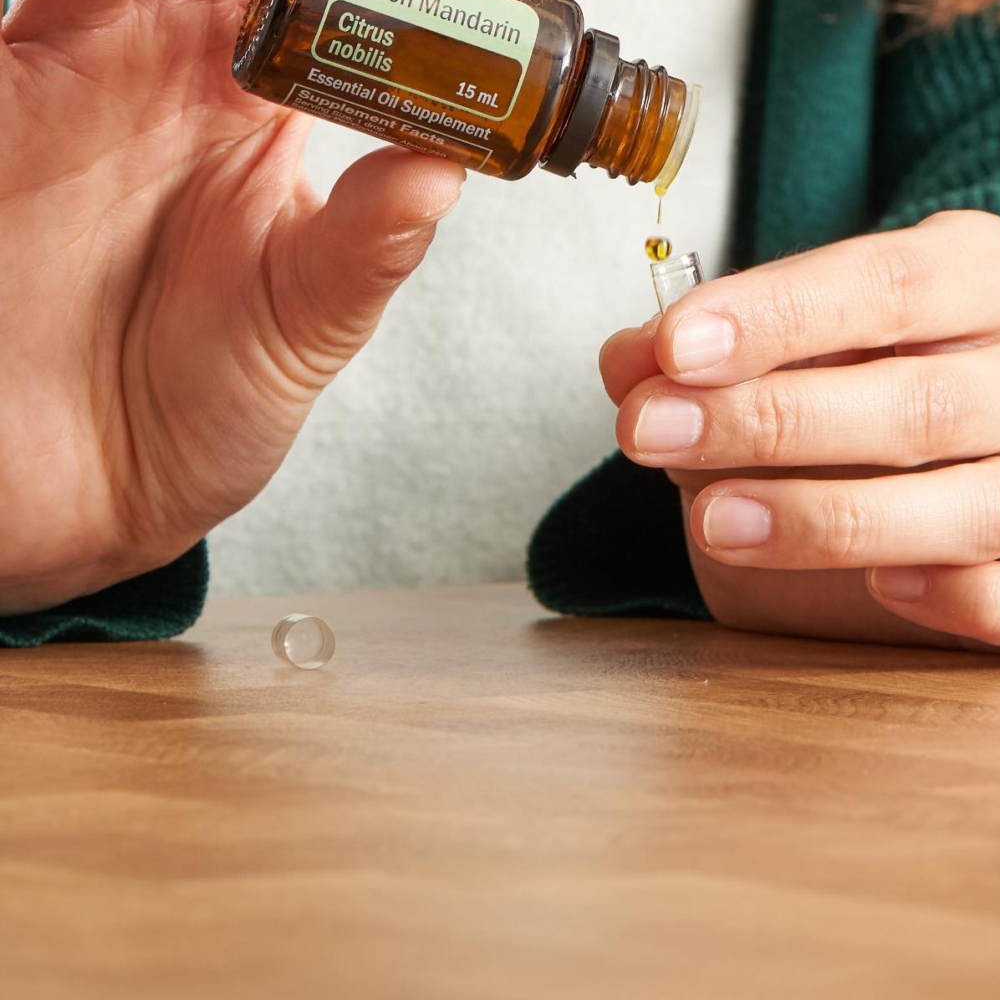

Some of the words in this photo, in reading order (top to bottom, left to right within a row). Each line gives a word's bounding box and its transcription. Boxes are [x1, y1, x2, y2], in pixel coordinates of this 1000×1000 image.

[338, 11, 395, 47] Citrus
[328, 39, 393, 73] nobilis
[307, 67, 376, 102] Essential
[377, 91, 400, 109] Oil
[400, 99, 492, 141] Supplement
[456, 81, 477, 99] 15
[477, 91, 498, 108] mL
[294, 97, 330, 114] Serving
[364, 121, 386, 133] drop
[298, 89, 397, 129] Supplement
[399, 123, 446, 145] Facts
